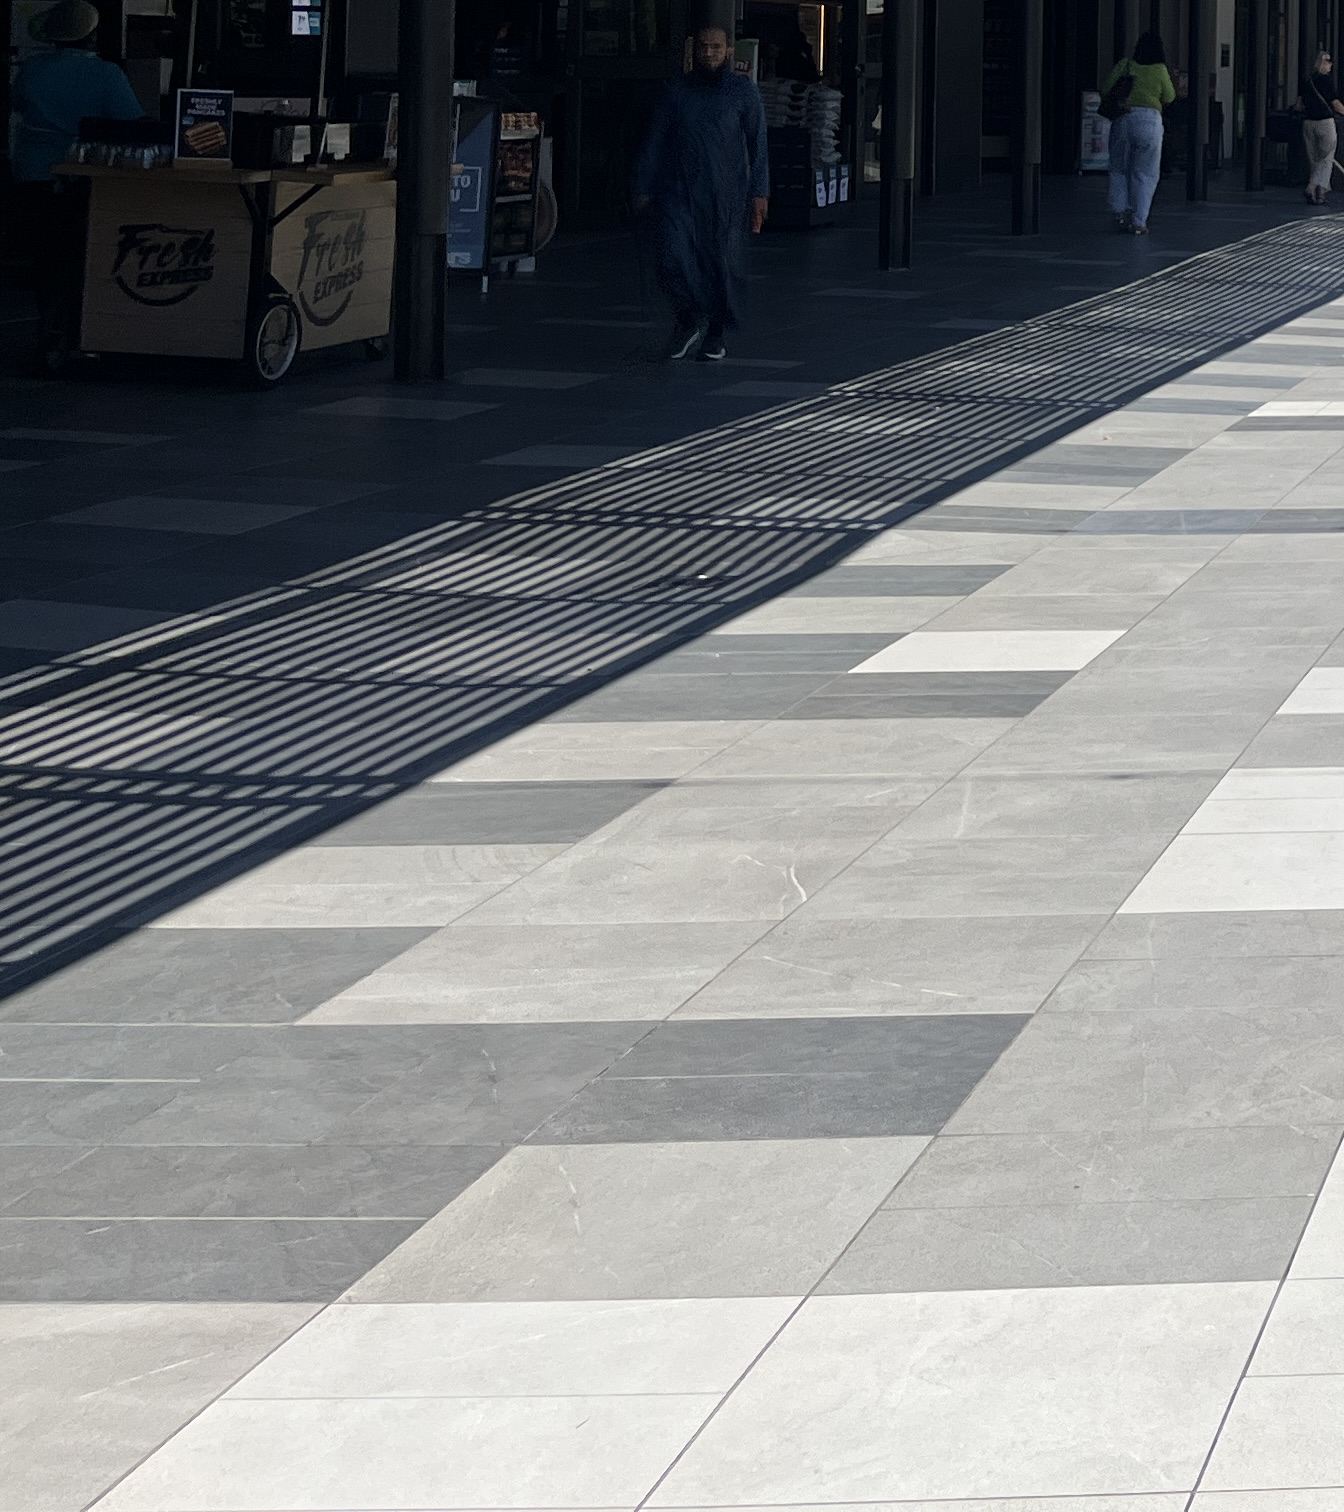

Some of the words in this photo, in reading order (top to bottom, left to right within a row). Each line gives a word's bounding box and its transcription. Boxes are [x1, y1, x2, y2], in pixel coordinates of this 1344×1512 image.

[112, 223, 215, 276] Fresh
[297, 210, 367, 292] Fresh
[137, 266, 214, 288] EXPRESS
[312, 260, 364, 304] EXPRESS
